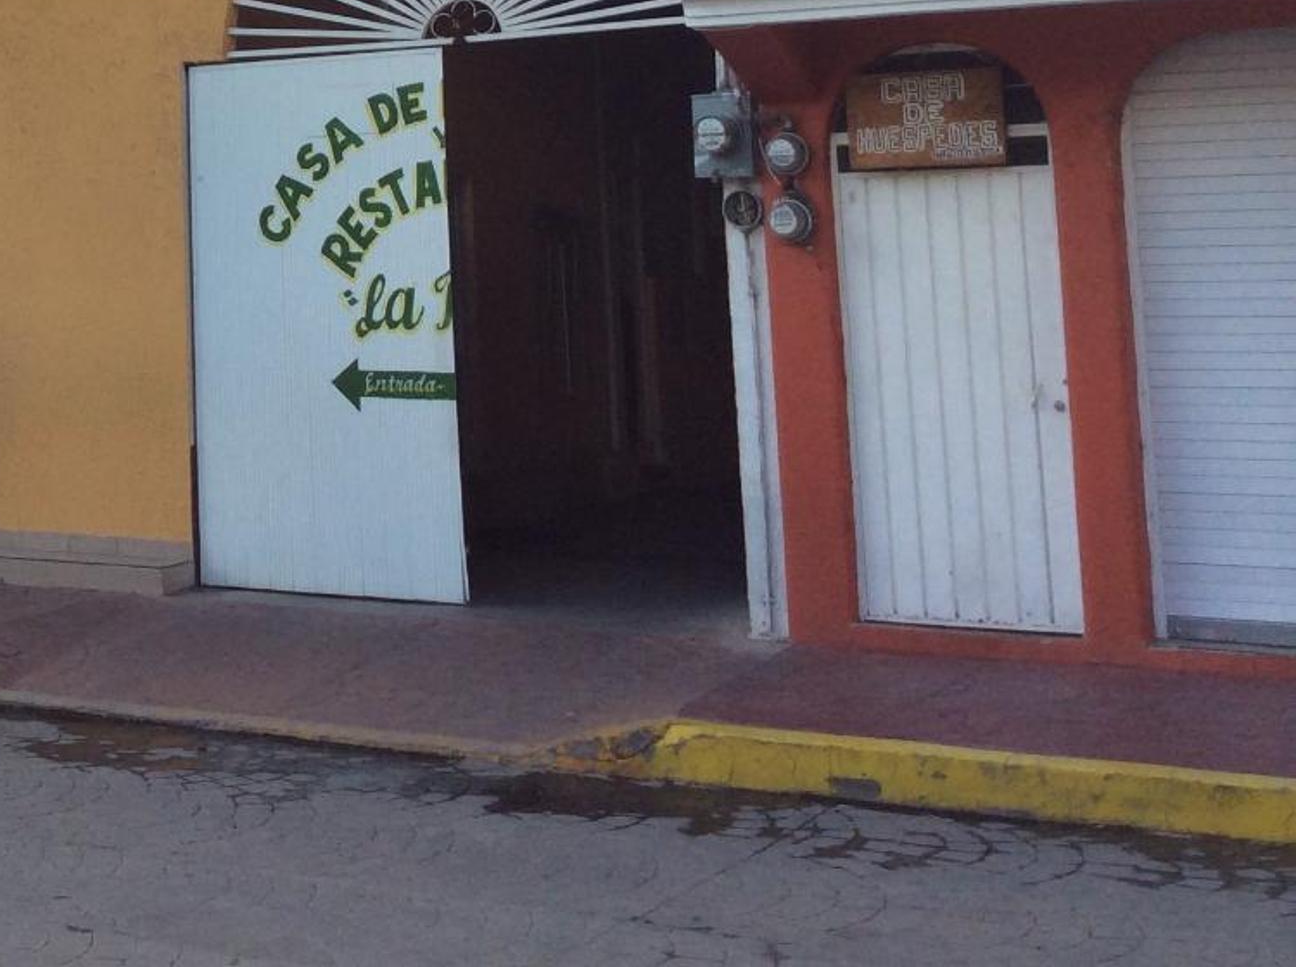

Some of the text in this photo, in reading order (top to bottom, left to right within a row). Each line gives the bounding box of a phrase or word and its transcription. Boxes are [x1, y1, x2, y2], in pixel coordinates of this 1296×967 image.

[880, 70, 966, 105] CASA
[903, 100, 945, 125] DE
[258, 81, 429, 243] CASA DE
[320, 159, 446, 279] RESTA
[364, 371, 437, 396] Entrada
